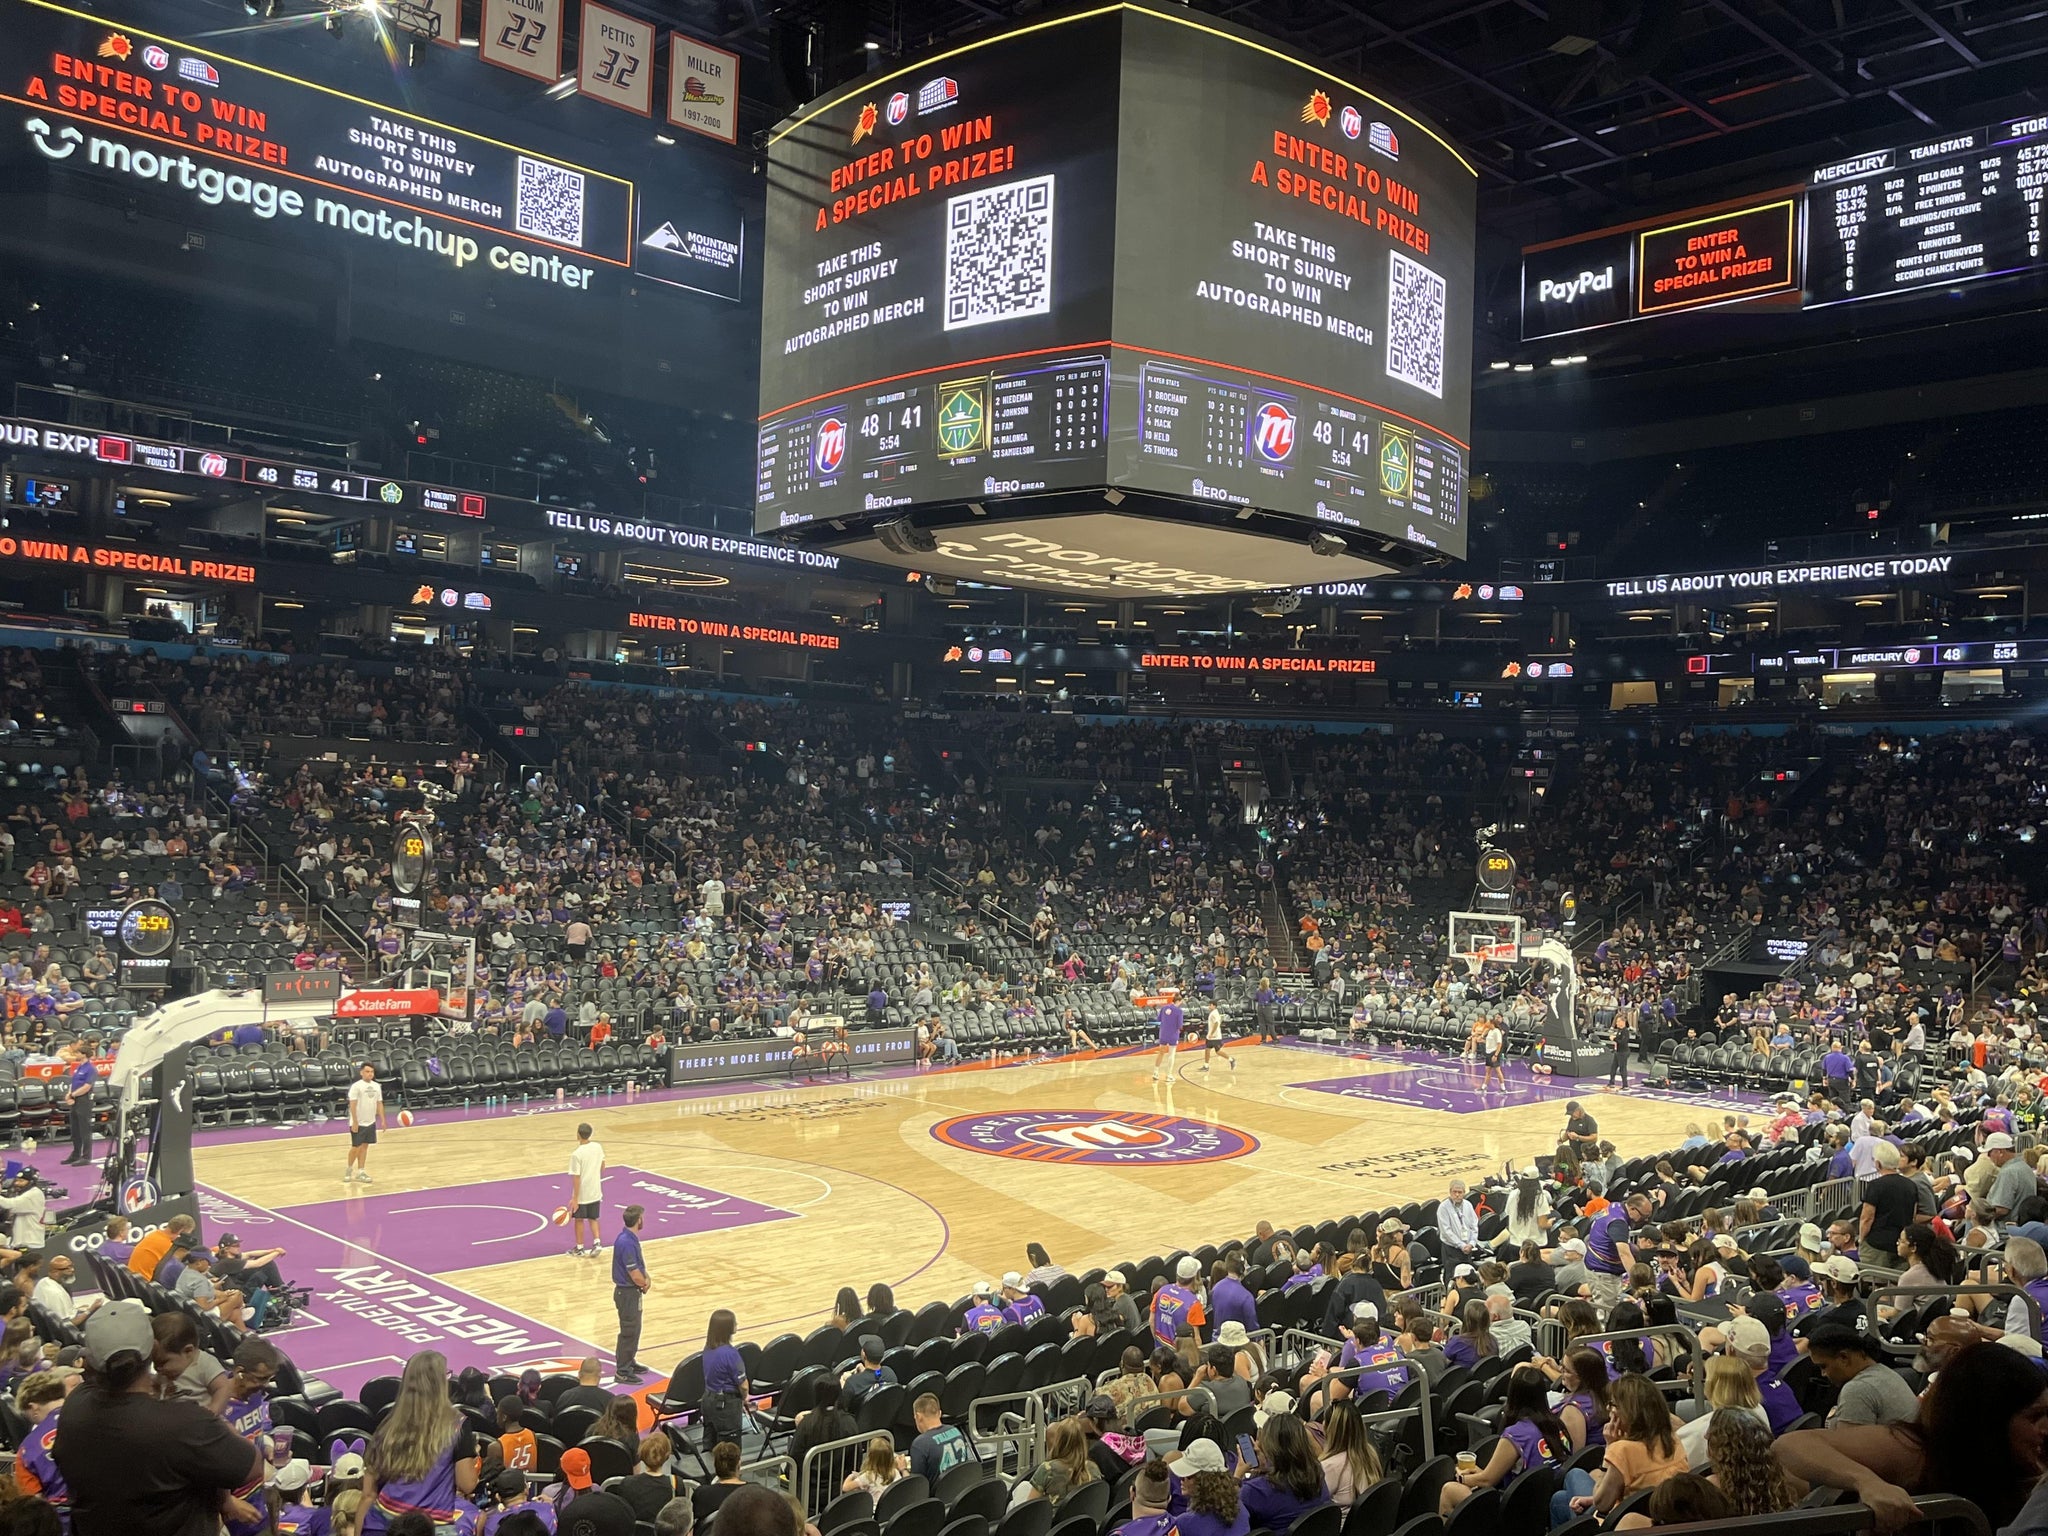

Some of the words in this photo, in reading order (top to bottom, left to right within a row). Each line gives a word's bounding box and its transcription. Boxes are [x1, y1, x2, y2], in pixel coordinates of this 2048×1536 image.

[497, 10, 547, 57] 22
[601, 24, 635, 48] PETTIS
[592, 46, 639, 89] 32
[688, 56, 722, 79] MILLER
[52, 53, 153, 100] ENTER
[162, 83, 201, 113] TO
[212, 97, 267, 132] WIN
[683, 91, 725, 106] Mercury
[26, 76, 48, 100] A
[58, 86, 187, 138] SPECIAL
[198, 122, 288, 165] PRIZE!
[683, 108, 721, 129] 1997-2000
[370, 116, 414, 141] TAKE
[418, 130, 457, 154] THIS
[349, 128, 407, 156] SHORT
[412, 147, 475, 176] SURVEY
[831, 145, 893, 193] ENTER
[901, 134, 933, 164] TO
[941, 116, 992, 152] WIN
[1910, 141, 1939, 160] TEAM
[1940, 136, 1973, 153] STATS
[381, 156, 404, 173] TO
[409, 164, 441, 184] WIN
[1273, 130, 1348, 181] ENTER
[1354, 163, 1381, 195] TO
[1387, 178, 1419, 216] WIN
[1814, 154, 1888, 183] MERCURY
[1918, 171, 1938, 183] FIELD
[1940, 166, 1964, 178] GOALS
[315, 155, 443, 202] AUTOGRAPHED
[448, 193, 502, 219] MERCH
[816, 208, 827, 232] A
[832, 176, 921, 226] SPECIAL
[929, 145, 1015, 191] PRIZE!
[1836, 185, 1867, 201] 50.0%
[1926, 180, 1961, 193] POINTERS
[2023, 187, 2043, 201] 11/2
[1251, 160, 1268, 187] A
[1277, 168, 1371, 226] SPECIAL
[1377, 208, 1430, 255] PRIZE!
[1836, 198, 1867, 213] 33.3%
[1915, 198, 1934, 210] FREE
[1935, 192, 1966, 206] THROWS
[89, 135, 303, 219] mortgage
[315, 197, 479, 266] matchup
[490, 244, 594, 291] center
[1835, 211, 1866, 226] 78.6%
[1900, 202, 1982, 227] REBOUNDS/OFFENSIVE
[1687, 229, 1738, 251] ENTER
[1839, 225, 1859, 239] 17/3
[1924, 222, 1955, 236] ASSISTS
[2027, 230, 2039, 242] 12
[688, 232, 738, 254] MOUNTAIN
[690, 244, 734, 263] AMERICA
[1254, 221, 1297, 250] TAKE
[1301, 236, 1336, 263] THIS
[1845, 239, 1855, 251] 12
[1918, 234, 1961, 250] TURNOVERS
[817, 251, 848, 278] TAKE
[851, 241, 882, 265] THIS
[1232, 240, 1291, 270] SHORT
[1294, 259, 1352, 291] SURVEY
[1676, 257, 1697, 272] TO
[1700, 248, 1732, 266] WIN
[1735, 245, 1747, 258] A
[1896, 255, 1923, 268] POINTS
[1924, 252, 1938, 263] OFF
[1939, 243, 1983, 260] TURNOVERS
[1654, 269, 1718, 293] SPECIAL
[1721, 257, 1772, 280] PRIZE!
[1895, 268, 1924, 282] SECOND
[1926, 263, 1954, 276] CHANCE
[1956, 257, 1983, 272] POINTS
[804, 275, 842, 305] SHORT
[845, 259, 898, 290] SURVEY
[1264, 273, 1287, 294] TO
[1291, 281, 1322, 304] WIN
[1540, 266, 1613, 303] PayPal
[824, 301, 840, 318] TO
[843, 290, 868, 312] WIN
[1196, 280, 1323, 328] AUTOGRAPHED
[1327, 318, 1373, 345] MERCH
[785, 312, 869, 355] AUTOGRAPHED
[873, 297, 925, 325] MERCH
[1155, 390, 1188, 404] BROCHANT
[901, 405, 921, 429] 41
[1002, 406, 1029, 417] JOHNSON
[1155, 404, 1179, 416] COPPER
[861, 413, 879, 437] 48
[1145, 430, 1152, 439] 10
[1154, 418, 1172, 429] MACK
[1313, 420, 1332, 445] 48
[136, 443, 168, 457] TIMEOUTS
[879, 434, 900, 450] 5:54
[1144, 445, 1153, 454] 25
[1153, 445, 1178, 457] THOMAS
[1352, 431, 1369, 455] 41
[146, 457, 168, 468] FOULS
[993, 450, 1000, 458] 33
[1332, 450, 1351, 466] 5:54
[257, 467, 278, 483] 48
[293, 474, 318, 489] 5:54
[331, 479, 349, 493] 41
[984, 479, 1020, 494] HERO
[1021, 481, 1045, 490] BREAD
[865, 496, 892, 510] HERO
[1193, 484, 1227, 500] HERO
[1317, 506, 1343, 522] HERO
[546, 510, 585, 530] TELL
[589, 518, 611, 533] US
[614, 522, 666, 543] ABOUT
[669, 532, 708, 549] YOUR
[711, 537, 795, 563] EXPERIENCE
[797, 551, 840, 569] TODAY
[0, 538, 16, 555] O
[21, 540, 68, 561] WIN
[72, 547, 90, 564] A
[94, 550, 186, 575] SPECIAL
[191, 560, 255, 583] PRIZE!
[1607, 582, 1643, 596] TELL
[1647, 579, 1667, 592] US
[1670, 576, 1717, 591] ABOUT
[1728, 570, 1773, 587] YOUR
[1777, 562, 1886, 583] EXPERIENCE
[1889, 556, 1952, 575] TODAY
[629, 612, 676, 631] ENTER
[679, 619, 698, 634] TO
[701, 621, 730, 637] WIN
[730, 626, 742, 638] A
[743, 627, 798, 645] SPECIAL
[800, 635, 839, 649] PRIZE!
[1142, 654, 1190, 668] ENTER
[1192, 656, 1212, 669] TO
[1216, 656, 1246, 669] WIN
[1248, 658, 1260, 669] A
[1262, 658, 1325, 672] SPECIAL
[1328, 660, 1376, 673] PRIZE!
[1852, 652, 1902, 664] MERCURY
[1943, 648, 1960, 661] 48
[1993, 647, 2018, 660] 5:54
[1488, 859, 1508, 870] 5:54
[137, 916, 169, 930] 5:54
[1767, 940, 1808, 949] mortgage
[679, 1056, 725, 1069] THERE'S
[730, 1053, 760, 1065] MORE
[766, 1051, 798, 1061] WHER
[855, 1043, 881, 1054] CAME
[886, 1040, 911, 1050] FROM
[1544, 1049, 1571, 1057] PRIDE
[41, 1067, 52, 1076] G
[970, 1113, 1079, 1144] PHOENIX
[1113, 1127, 1204, 1161] MERCURY
[315, 1265, 564, 1355] MERCURY
[316, 1289, 445, 1343] PHOENIX
[511, 1444, 532, 1468] 25
